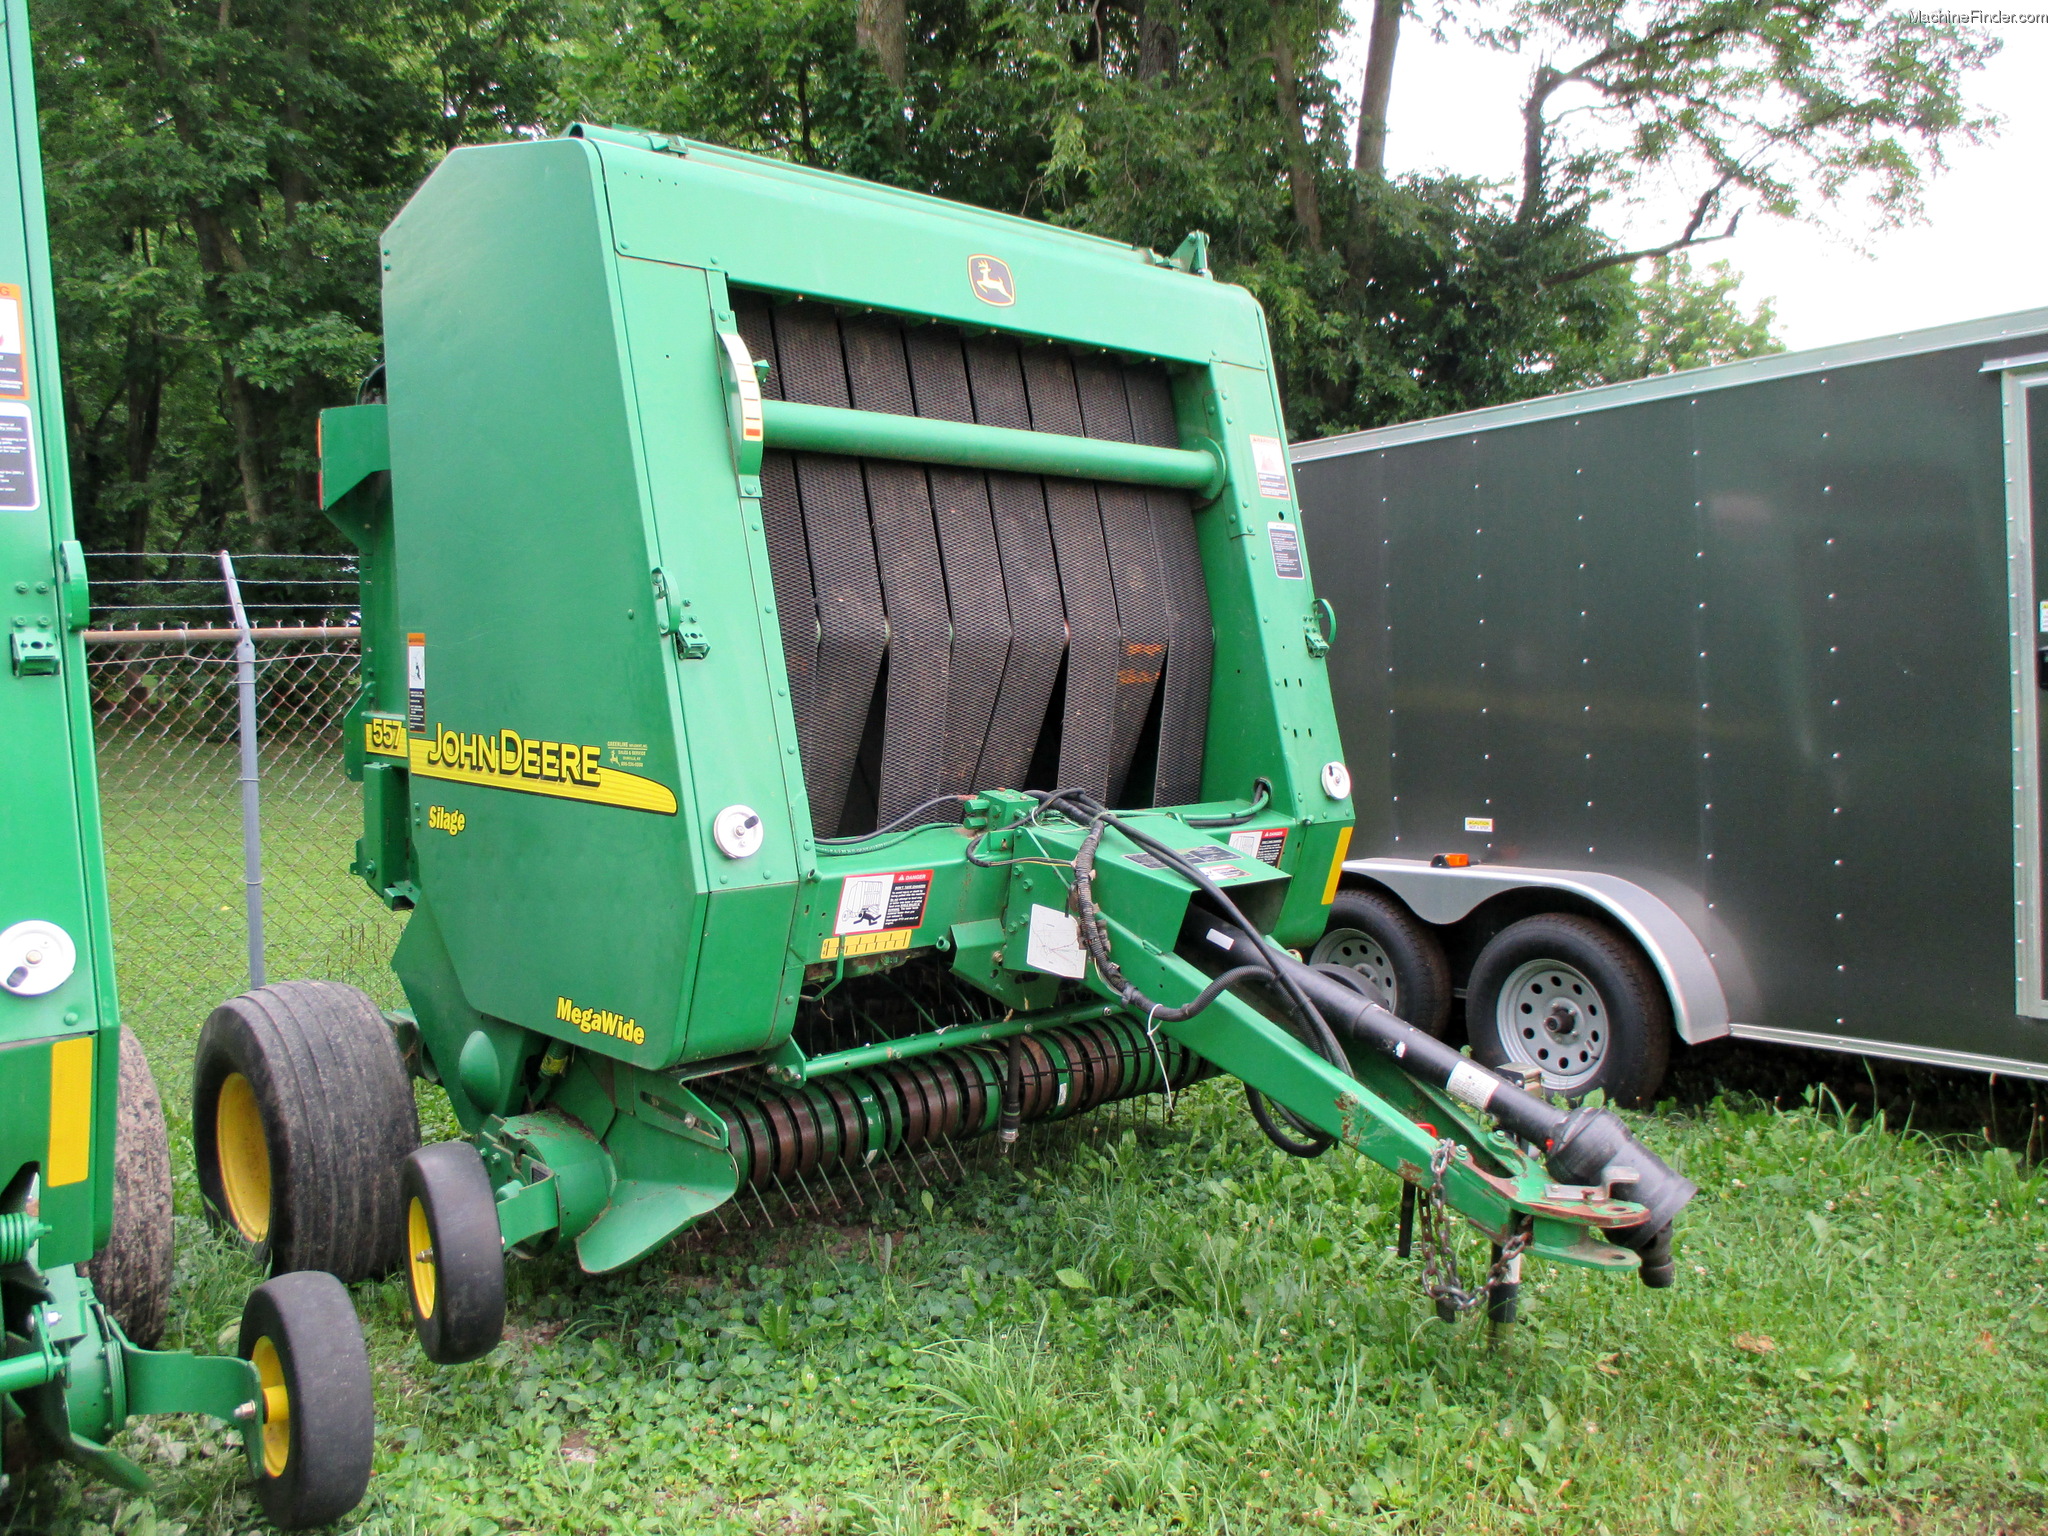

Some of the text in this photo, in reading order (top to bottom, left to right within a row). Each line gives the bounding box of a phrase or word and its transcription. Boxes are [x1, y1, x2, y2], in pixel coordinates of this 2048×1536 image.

[372, 718, 403, 749] 557
[427, 722, 602, 787] JOHN DEERE
[428, 804, 466, 836] Silage
[556, 996, 645, 1045] MegaWide
